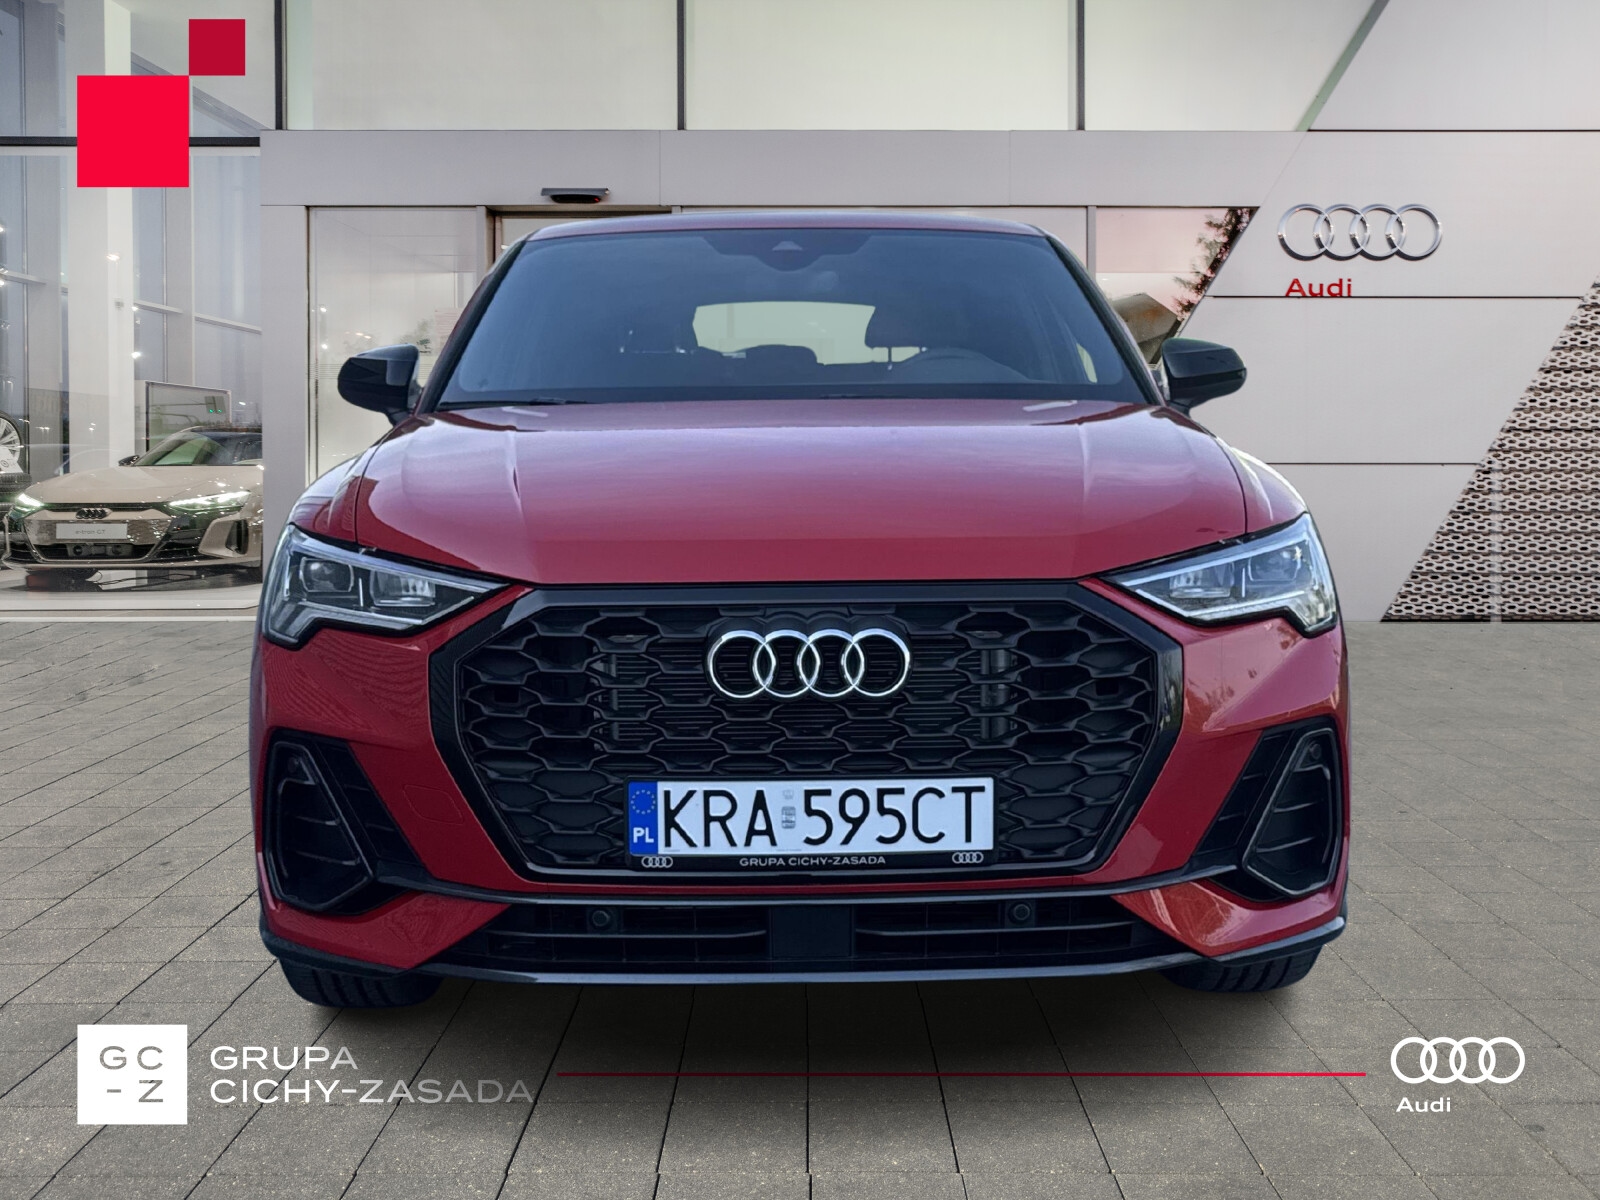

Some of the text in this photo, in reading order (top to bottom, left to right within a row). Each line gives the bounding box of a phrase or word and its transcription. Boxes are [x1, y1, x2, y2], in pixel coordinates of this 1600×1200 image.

[1285, 278, 1352, 297] Audi
[663, 786, 986, 848] KRA 595CT
[633, 828, 654, 844] PL
[739, 855, 886, 867] GRUPA CICHY-ZASADA
